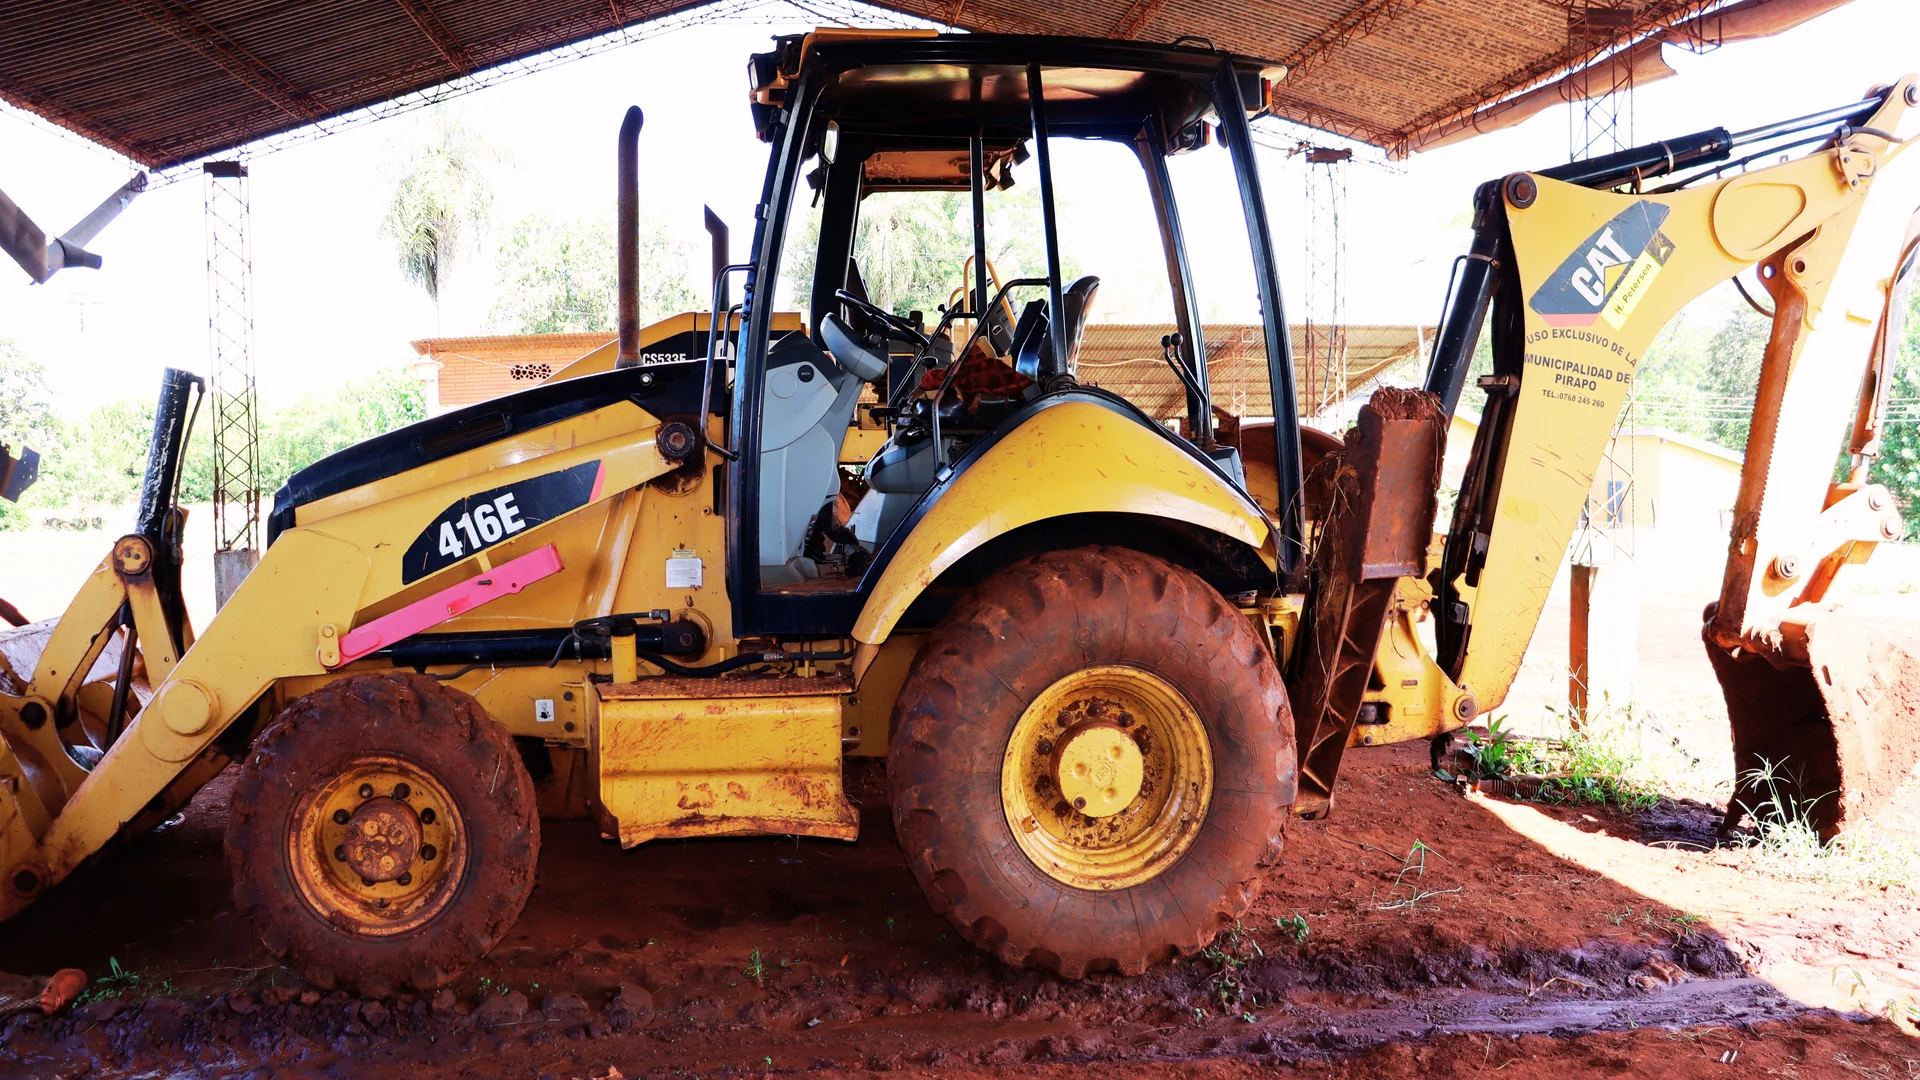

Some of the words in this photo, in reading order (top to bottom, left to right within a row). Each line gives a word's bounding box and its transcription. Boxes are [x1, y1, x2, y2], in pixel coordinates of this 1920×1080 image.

[1571, 226, 1632, 307] CAT
[1614, 304, 1625, 315] H.
[1622, 263, 1652, 303] Petersen
[1524, 352, 1613, 380] MUNICIPALIDAD
[1616, 371, 1631, 384] DE
[1526, 330, 1549, 344] USO
[1552, 328, 1609, 348] EXCLUSIVO
[1610, 342, 1625, 357] DE
[1625, 352, 1638, 368] LA
[1555, 373, 1597, 391] PIRAPO
[1578, 396, 1591, 405] 245
[1592, 399, 1605, 408] 260
[438, 492, 527, 558] 416E
